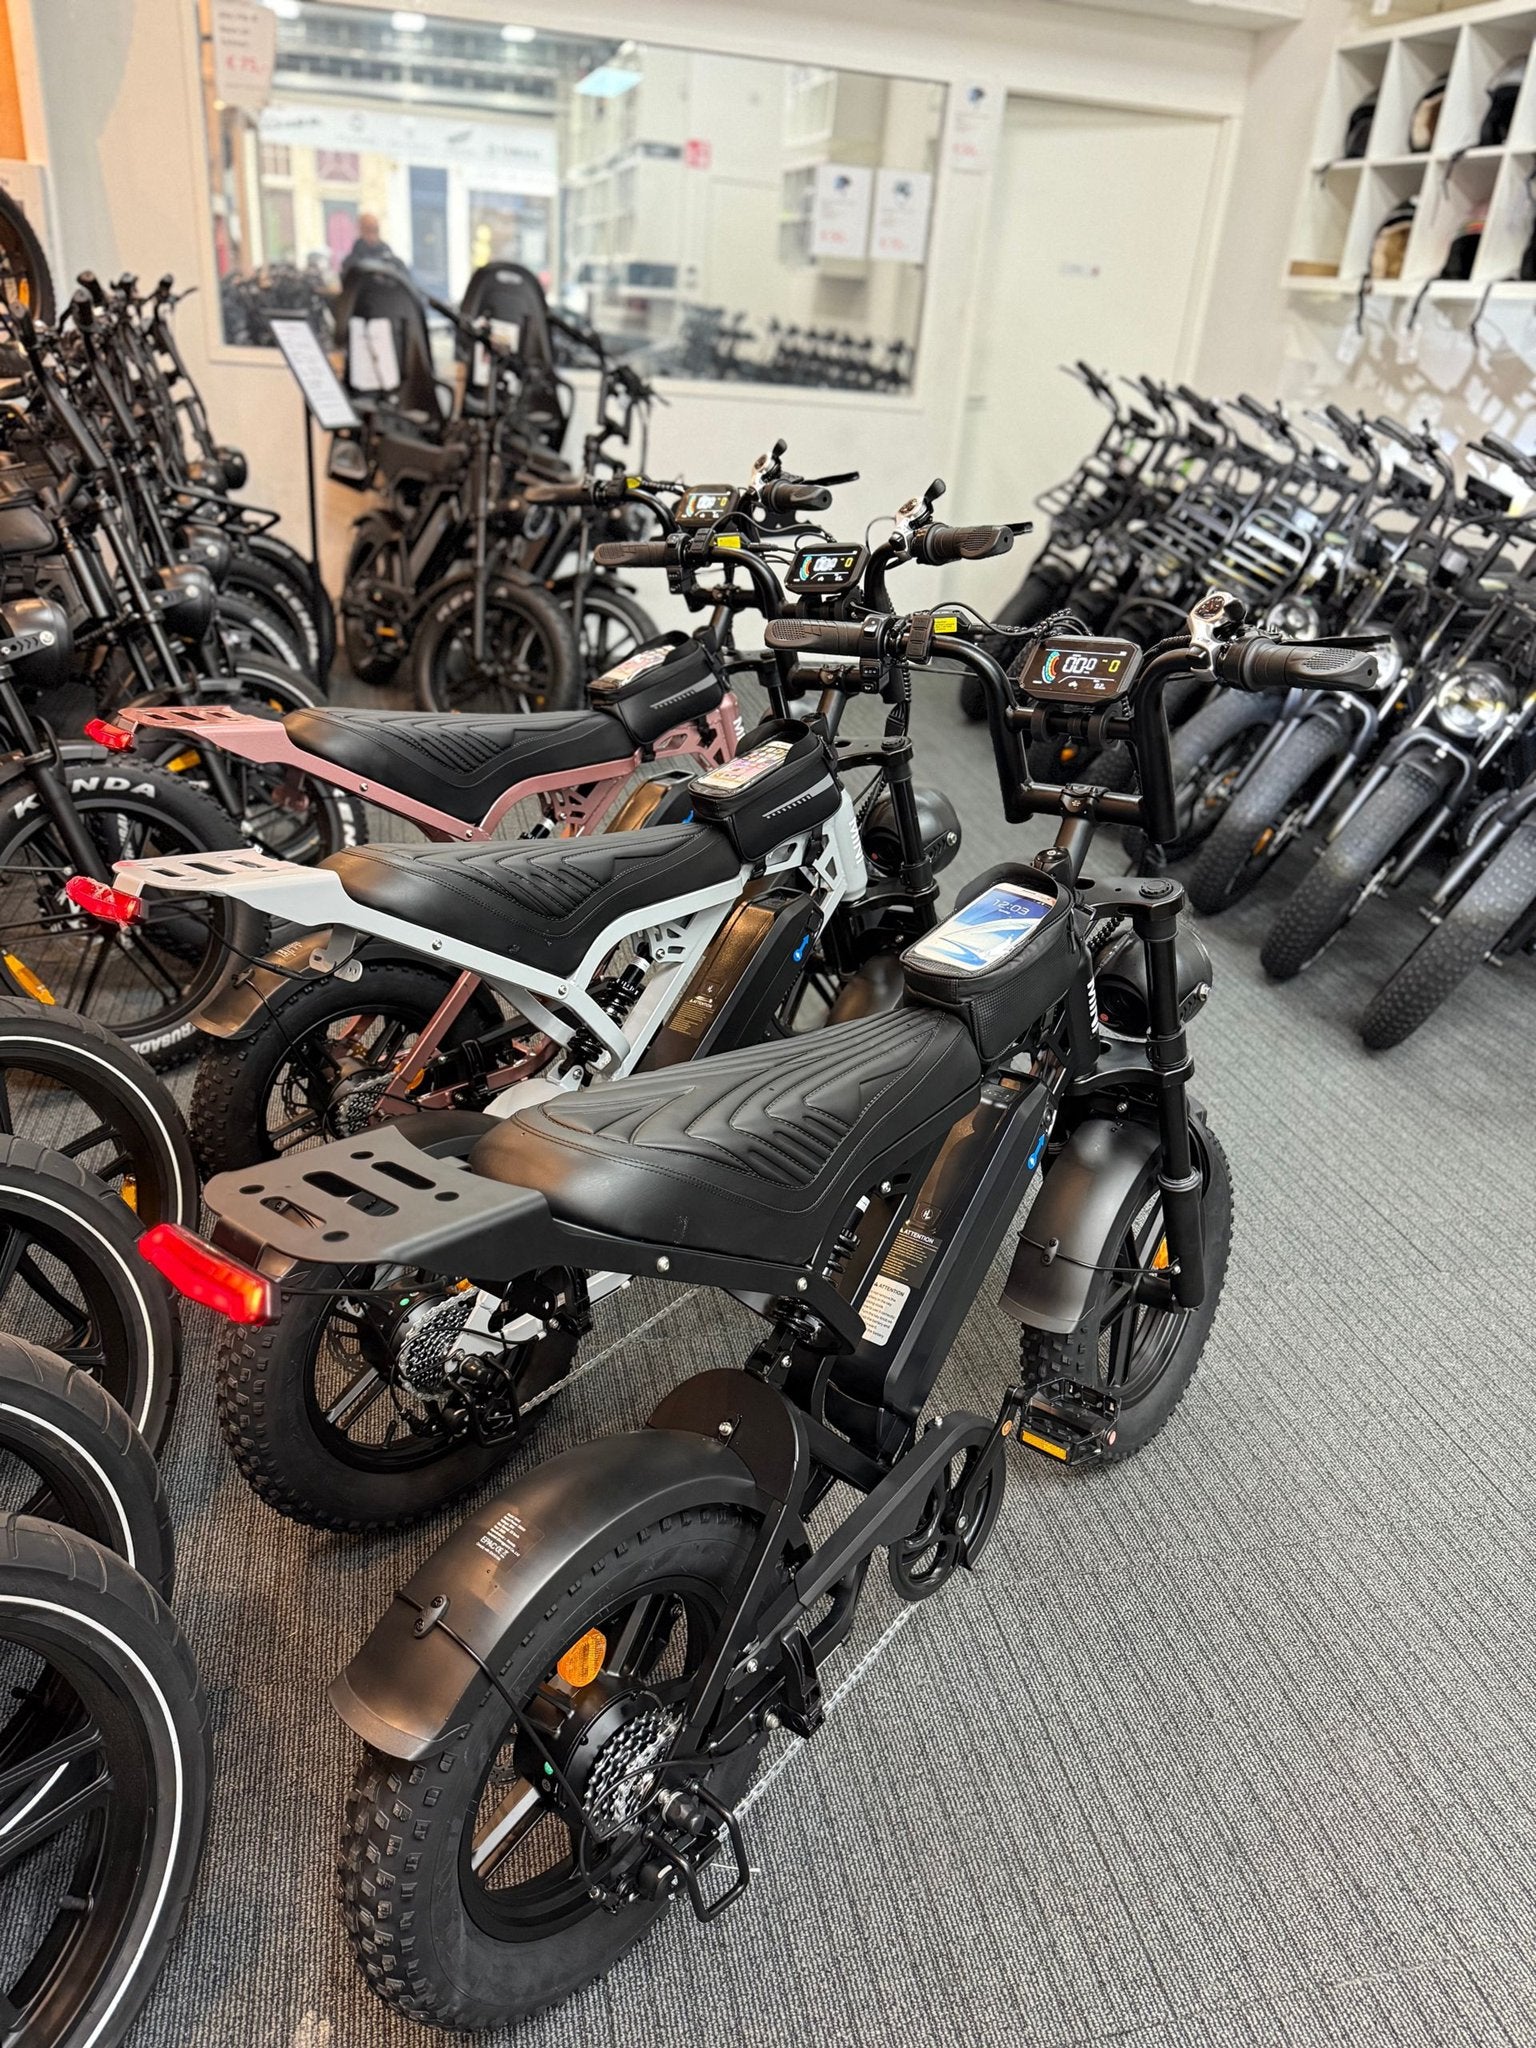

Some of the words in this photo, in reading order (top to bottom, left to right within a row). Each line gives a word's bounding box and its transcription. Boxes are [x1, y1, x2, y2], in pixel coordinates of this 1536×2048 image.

[12, 776, 156, 819] KNDA
[848, 816, 865, 865] MINI
[992, 899, 1030, 916] 12:03
[1086, 976, 1099, 1034] MINI
[904, 1229, 935, 1244] ATTENTION
[878, 1283, 905, 1297] ATTENTION
[480, 1535, 498, 1550] EPAC
